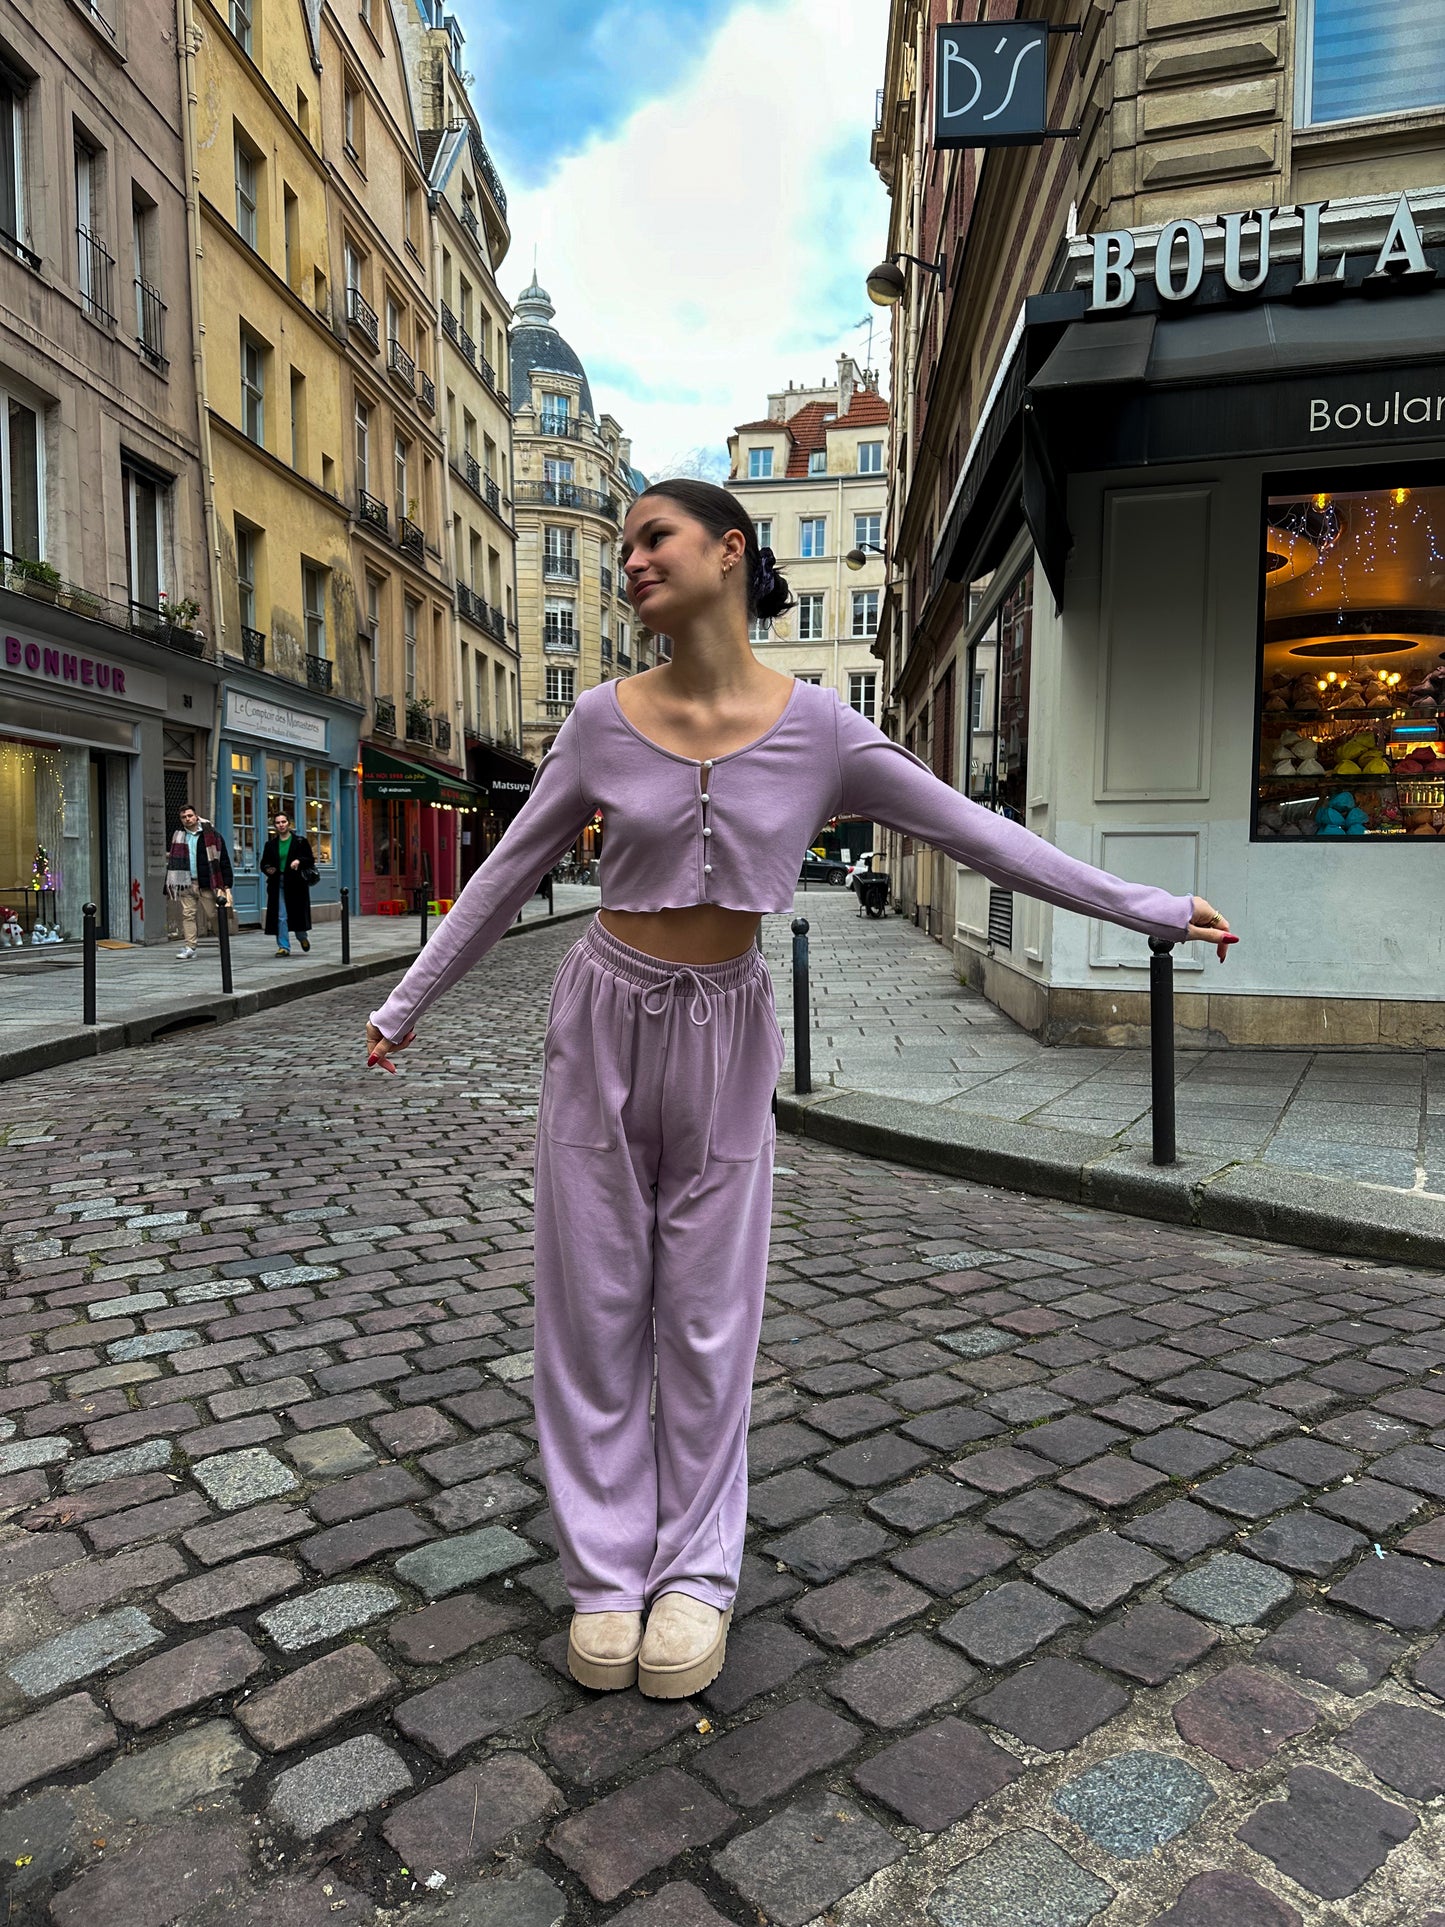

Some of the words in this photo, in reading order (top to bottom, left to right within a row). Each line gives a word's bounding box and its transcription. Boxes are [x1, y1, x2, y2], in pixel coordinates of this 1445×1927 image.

[5, 635, 126, 693] BONHEUR
[234, 695, 244, 714] Le
[245, 699, 275, 725] Comptoir
[275, 709, 286, 725] des
[492, 781, 531, 793] Matsuya
